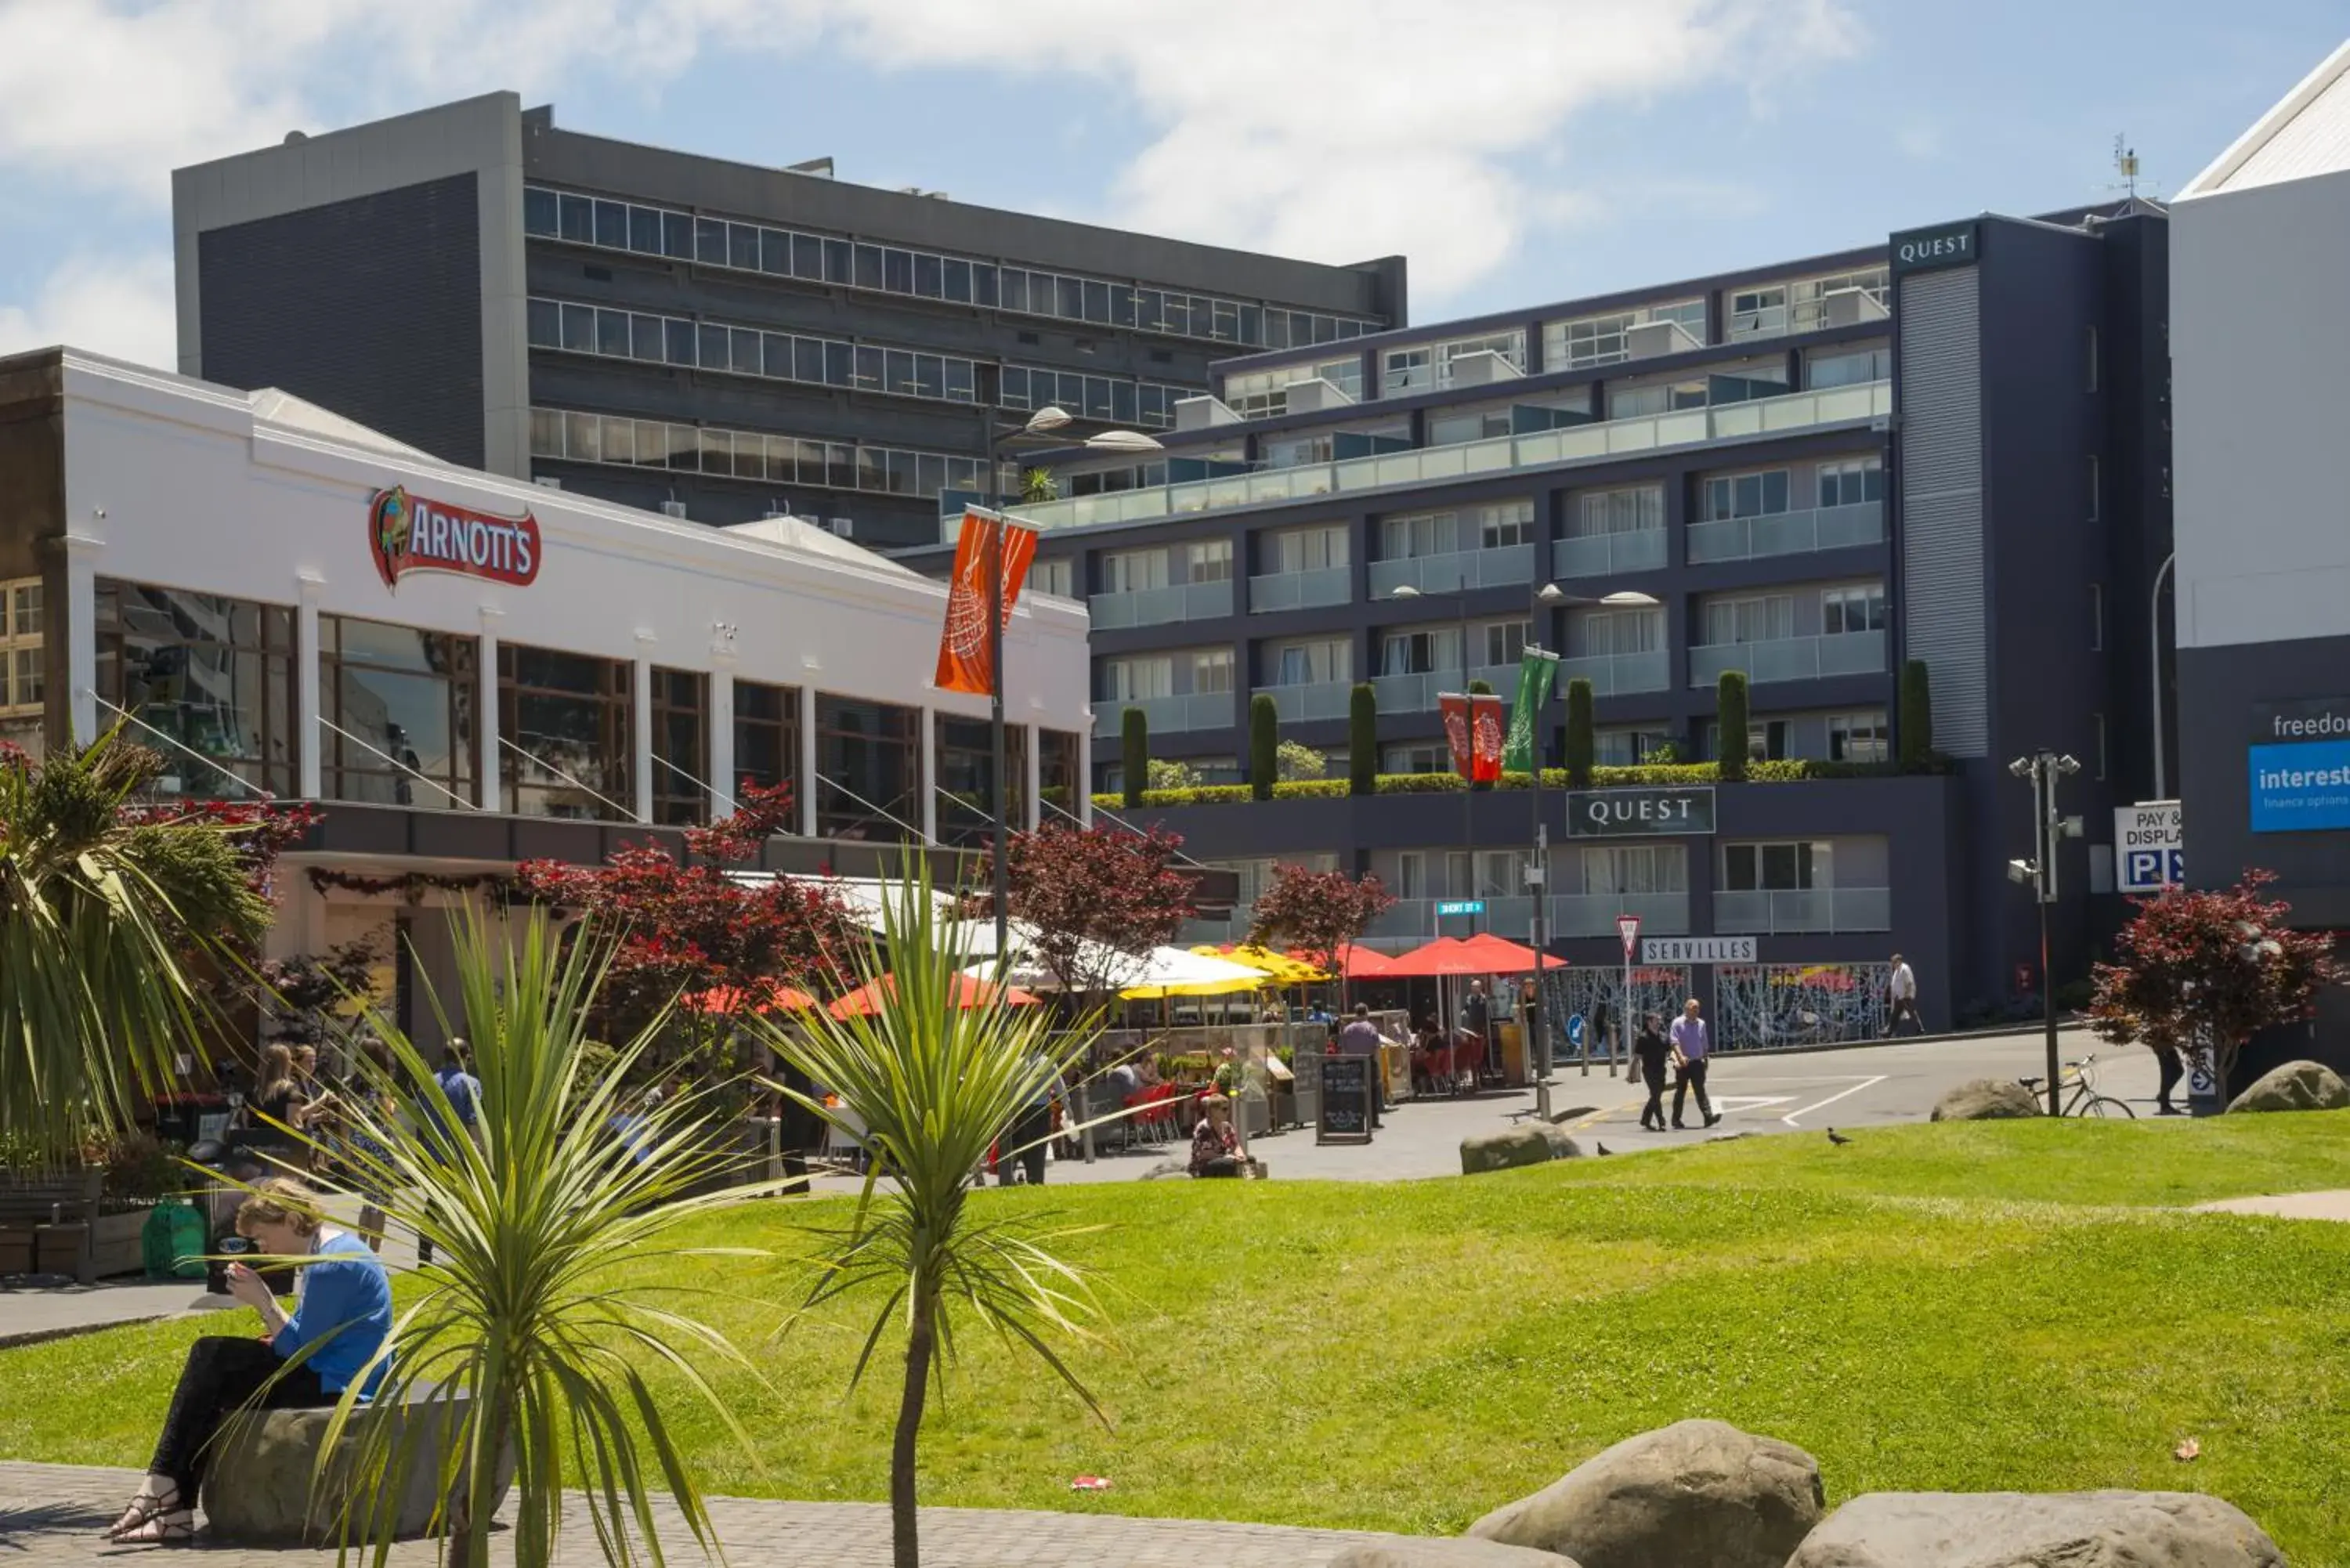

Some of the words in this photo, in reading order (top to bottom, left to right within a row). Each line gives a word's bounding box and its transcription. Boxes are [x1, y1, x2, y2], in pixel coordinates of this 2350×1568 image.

[1900, 235, 1968, 262] QUEST
[411, 503, 532, 574] ARNOTT'S
[2274, 712, 2350, 735] freedo
[2259, 765, 2350, 789] interest
[1589, 799, 1692, 825] QUEST
[2136, 812, 2165, 827] PAY
[2127, 829, 2182, 845] DISPLA
[2133, 854, 2157, 882] P
[1648, 941, 1751, 959] SERVILLES
